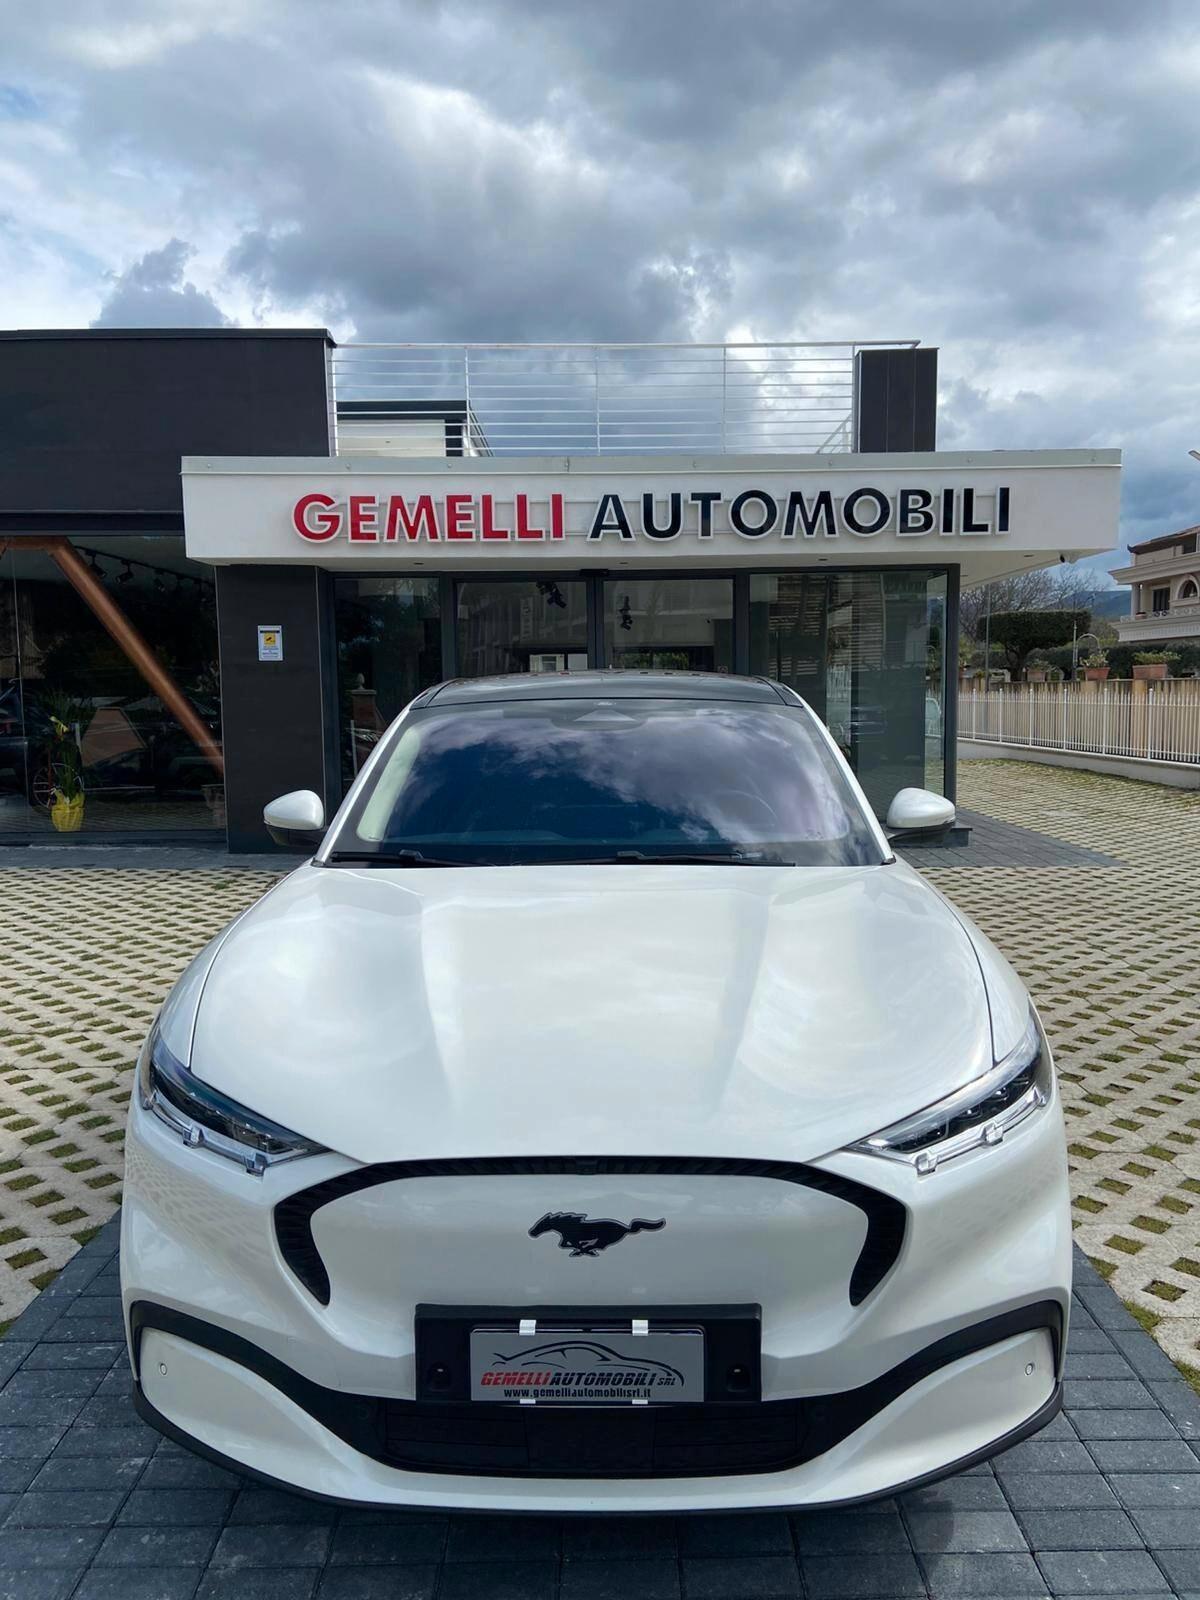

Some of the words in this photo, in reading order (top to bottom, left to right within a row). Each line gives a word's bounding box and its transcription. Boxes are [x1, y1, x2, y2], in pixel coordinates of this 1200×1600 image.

[292, 493, 565, 542] GEMELLI
[587, 487, 1011, 541] AUTOMOBILI
[657, 1378, 677, 1386] SRL
[504, 1388, 651, 1399] www.gemelliautomobilisrl.it
